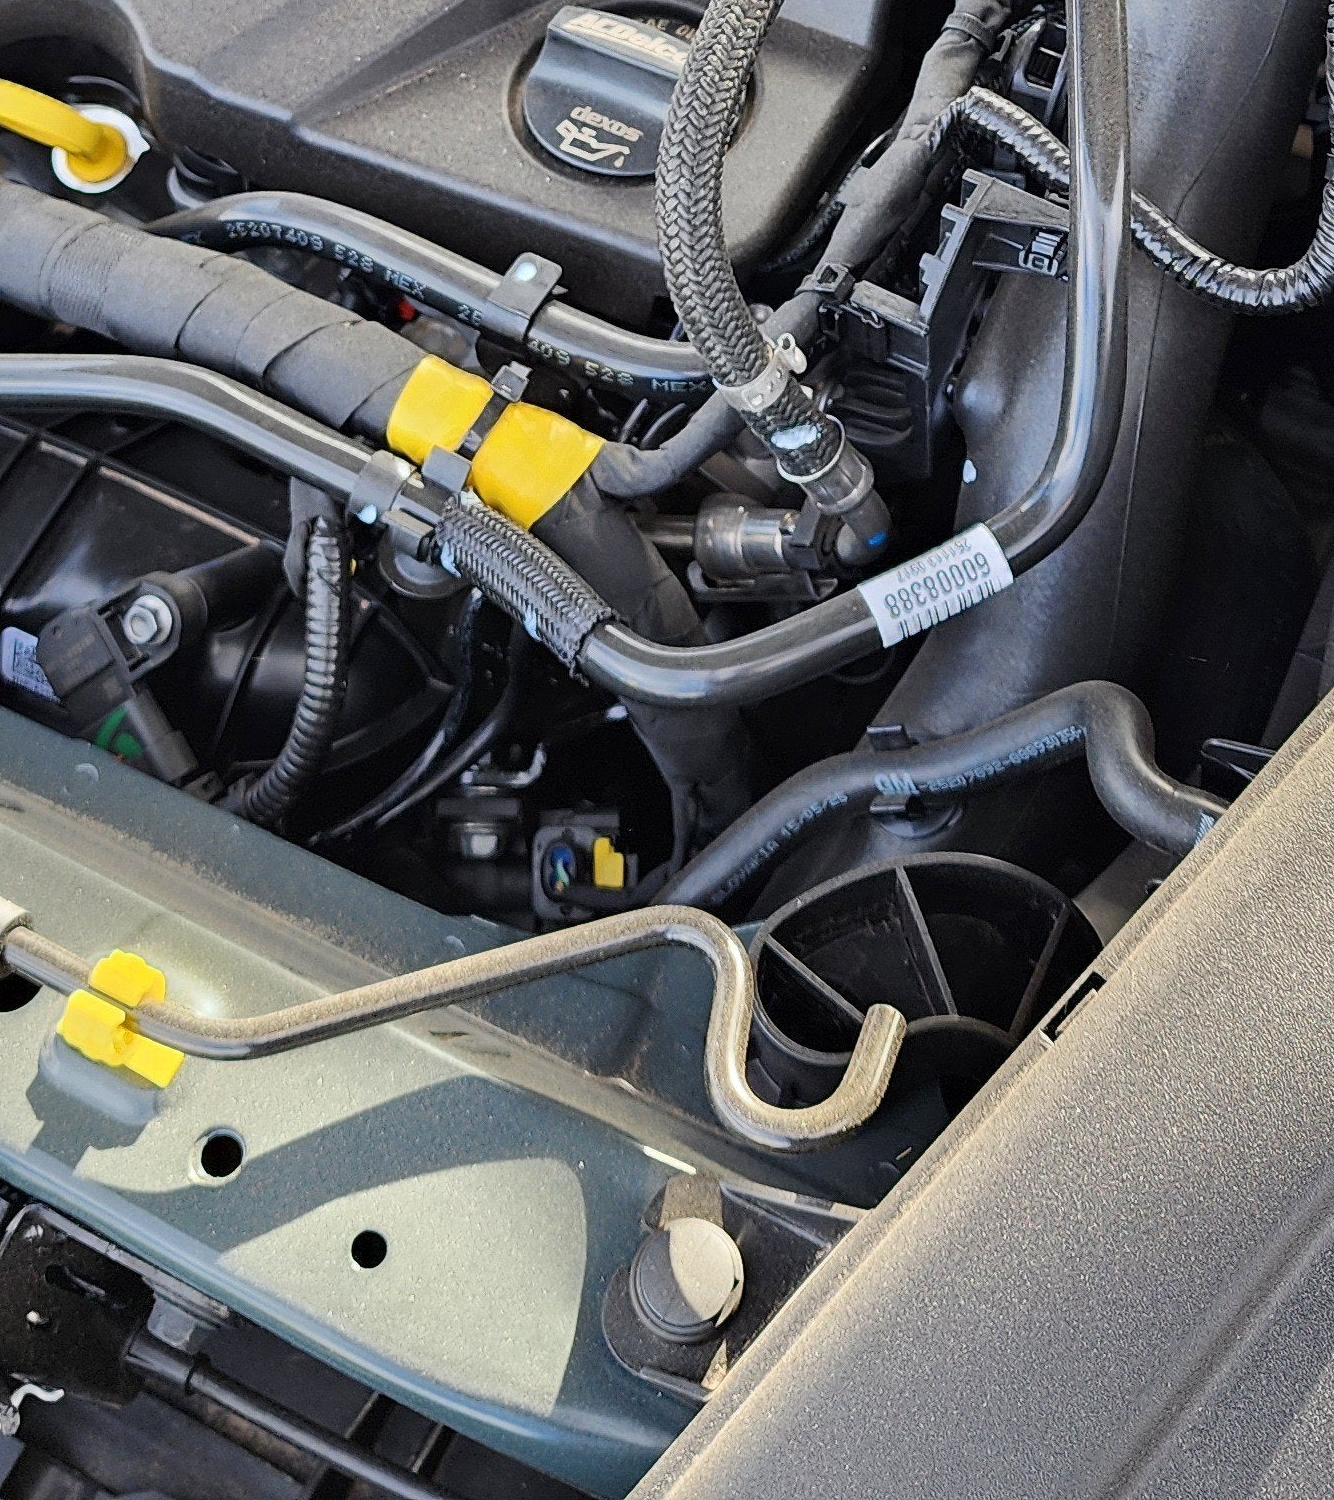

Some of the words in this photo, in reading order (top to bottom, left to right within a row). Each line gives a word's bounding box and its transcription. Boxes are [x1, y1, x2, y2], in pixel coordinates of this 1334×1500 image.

[570, 105, 644, 143] dexos
[384, 266, 427, 301] MEX
[651, 377, 709, 393] MEX
[883, 551, 992, 620] 60008388
